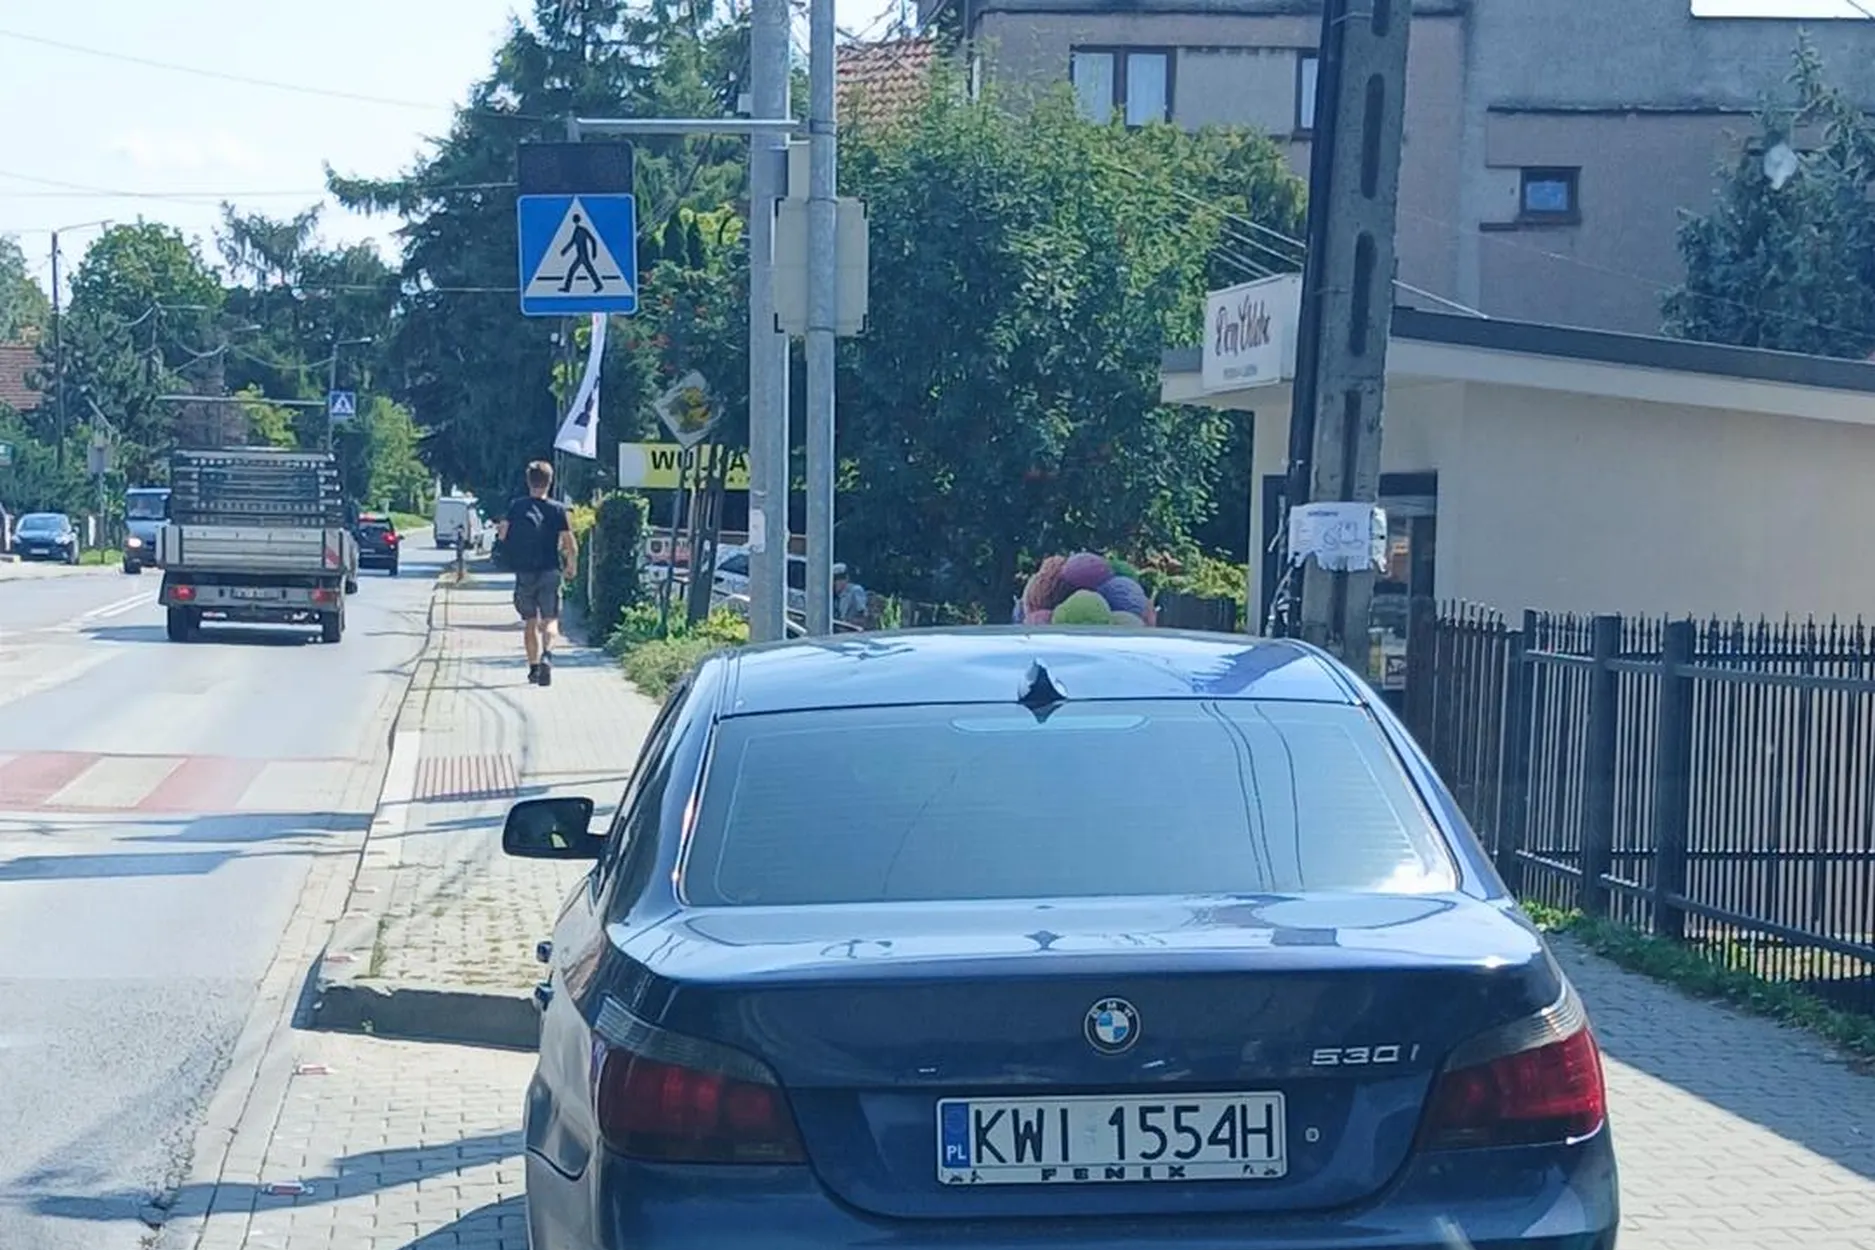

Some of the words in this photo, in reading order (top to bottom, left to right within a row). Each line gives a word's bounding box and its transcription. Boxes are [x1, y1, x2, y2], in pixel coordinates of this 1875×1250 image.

[1090, 1001, 1133, 1019] BMW
[974, 1107, 1070, 1164] KWI
[1108, 1103, 1273, 1161] 1554H
[946, 1143, 967, 1161] PL
[1041, 1165, 1186, 1181] FENIX
